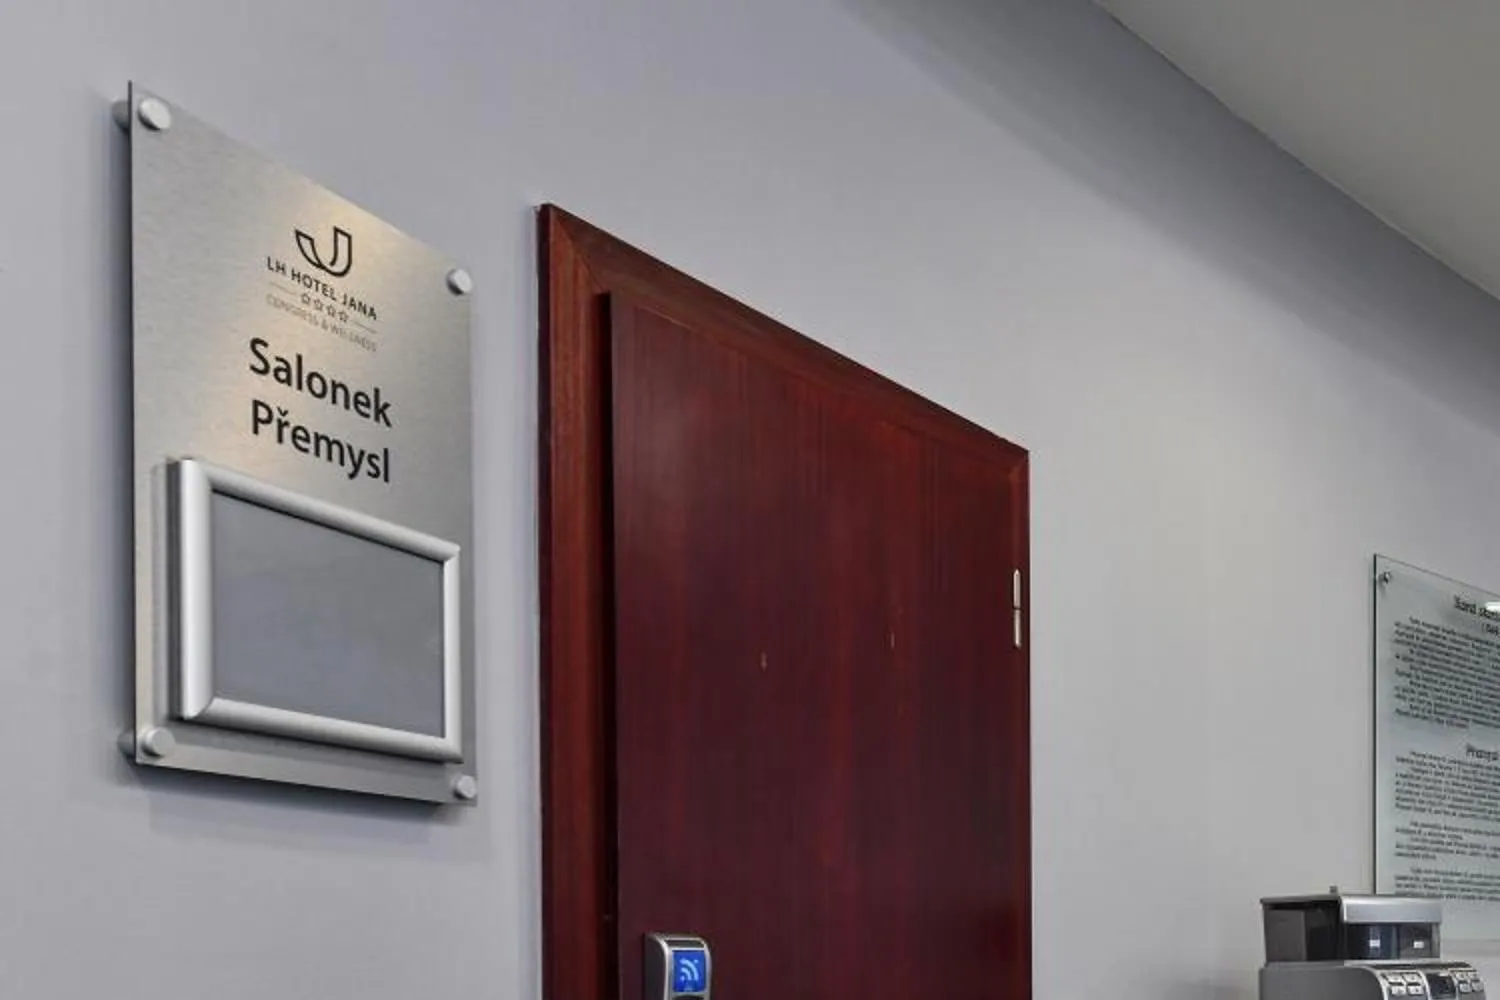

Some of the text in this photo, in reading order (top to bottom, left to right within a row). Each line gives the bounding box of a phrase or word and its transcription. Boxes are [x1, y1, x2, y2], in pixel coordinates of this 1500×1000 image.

[266, 255, 377, 321] LH HOTEL JANA
[249, 337, 393, 428] Salonek
[252, 399, 389, 483] Přemysl
